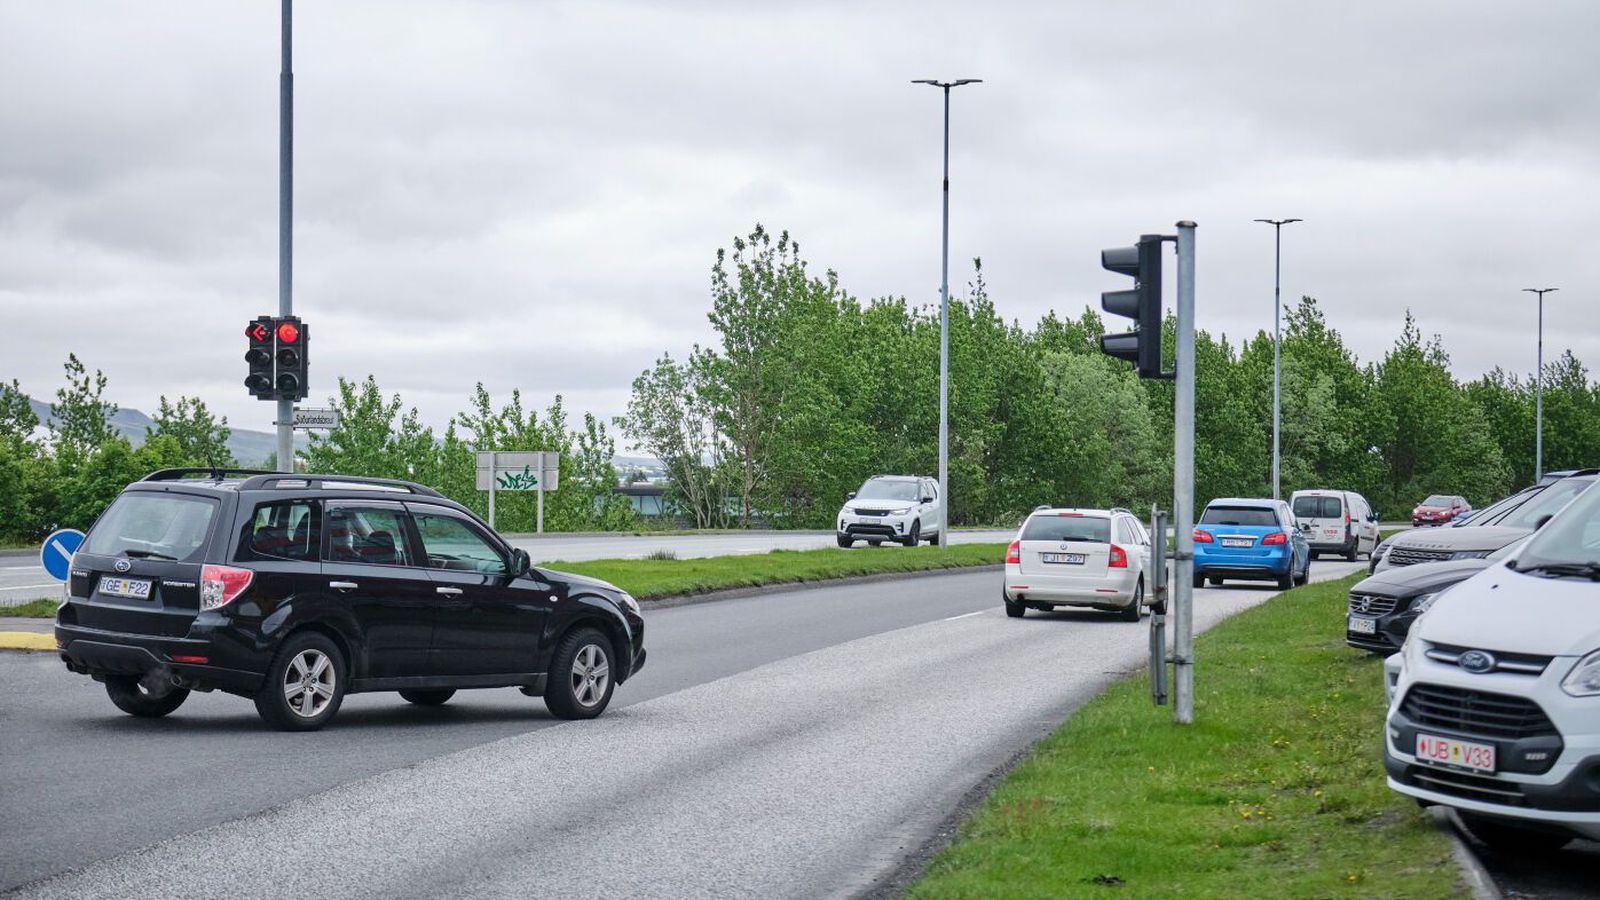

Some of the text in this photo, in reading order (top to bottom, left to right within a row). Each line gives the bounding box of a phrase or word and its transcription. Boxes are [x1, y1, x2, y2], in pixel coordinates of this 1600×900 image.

[105, 579, 149, 596] GE F22
[1428, 739, 1492, 769] UB V33
